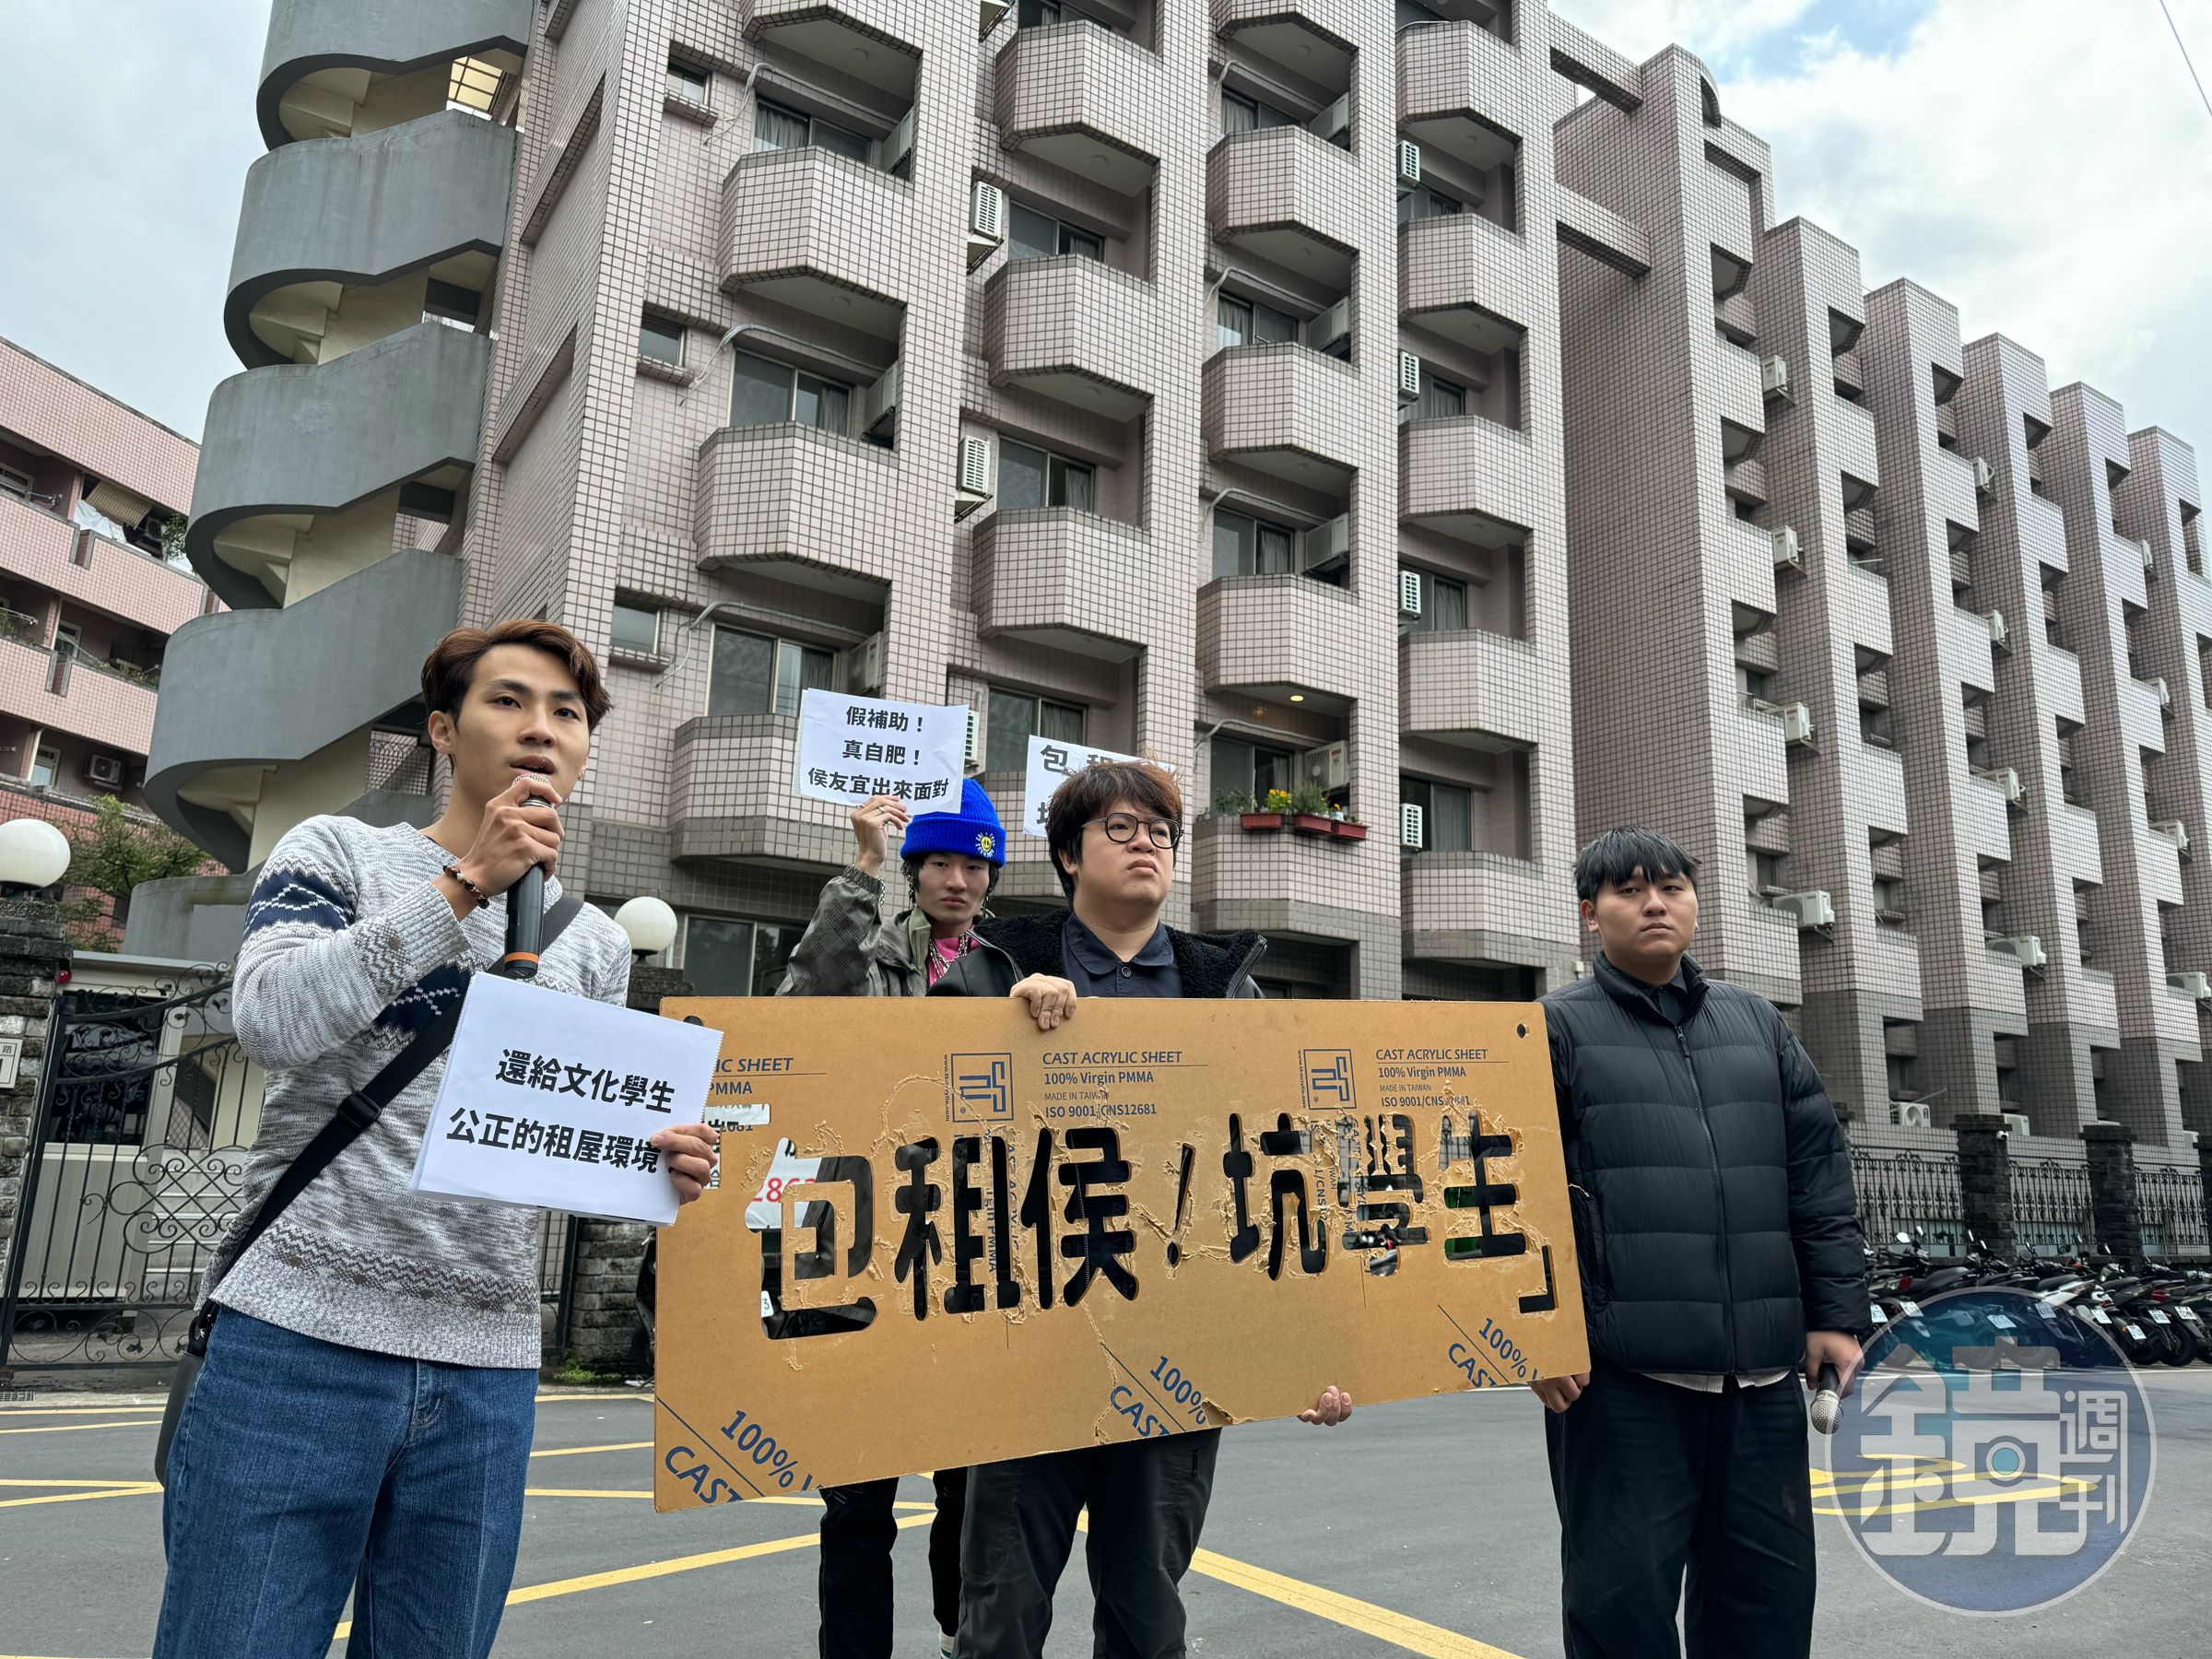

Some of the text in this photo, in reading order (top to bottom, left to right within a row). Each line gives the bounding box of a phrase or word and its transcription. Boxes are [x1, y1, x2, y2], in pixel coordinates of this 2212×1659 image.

[845, 705, 924, 733] 假補助！
[841, 739, 921, 766] 真自肥！
[807, 767, 949, 801] 侯友宜出來面對
[1042, 1051, 1183, 1065] CAST ACRYLIC SHEET
[1375, 1048, 1488, 1061] CAST ACRYLIC SHEET
[736, 1057, 794, 1073] SHEET
[1378, 1065, 1467, 1080] 100% Virgin PMMA
[494, 1048, 676, 1114] 還給文化學生
[1043, 1070, 1154, 1087] 100% Virgin PMMA
[1044, 1091, 1068, 1101] MADE
[1068, 1091, 1077, 1100] IN
[1379, 1083, 1431, 1093] MADE IN TAIWAN
[1381, 1096, 1398, 1108] ISO
[1045, 1105, 1065, 1118] ISO
[445, 1107, 663, 1174] 公正的租屋環境
[1478, 1317, 1528, 1379] 100%
[1149, 1355, 1207, 1425] 100%
[721, 1409, 798, 1488] 100%
